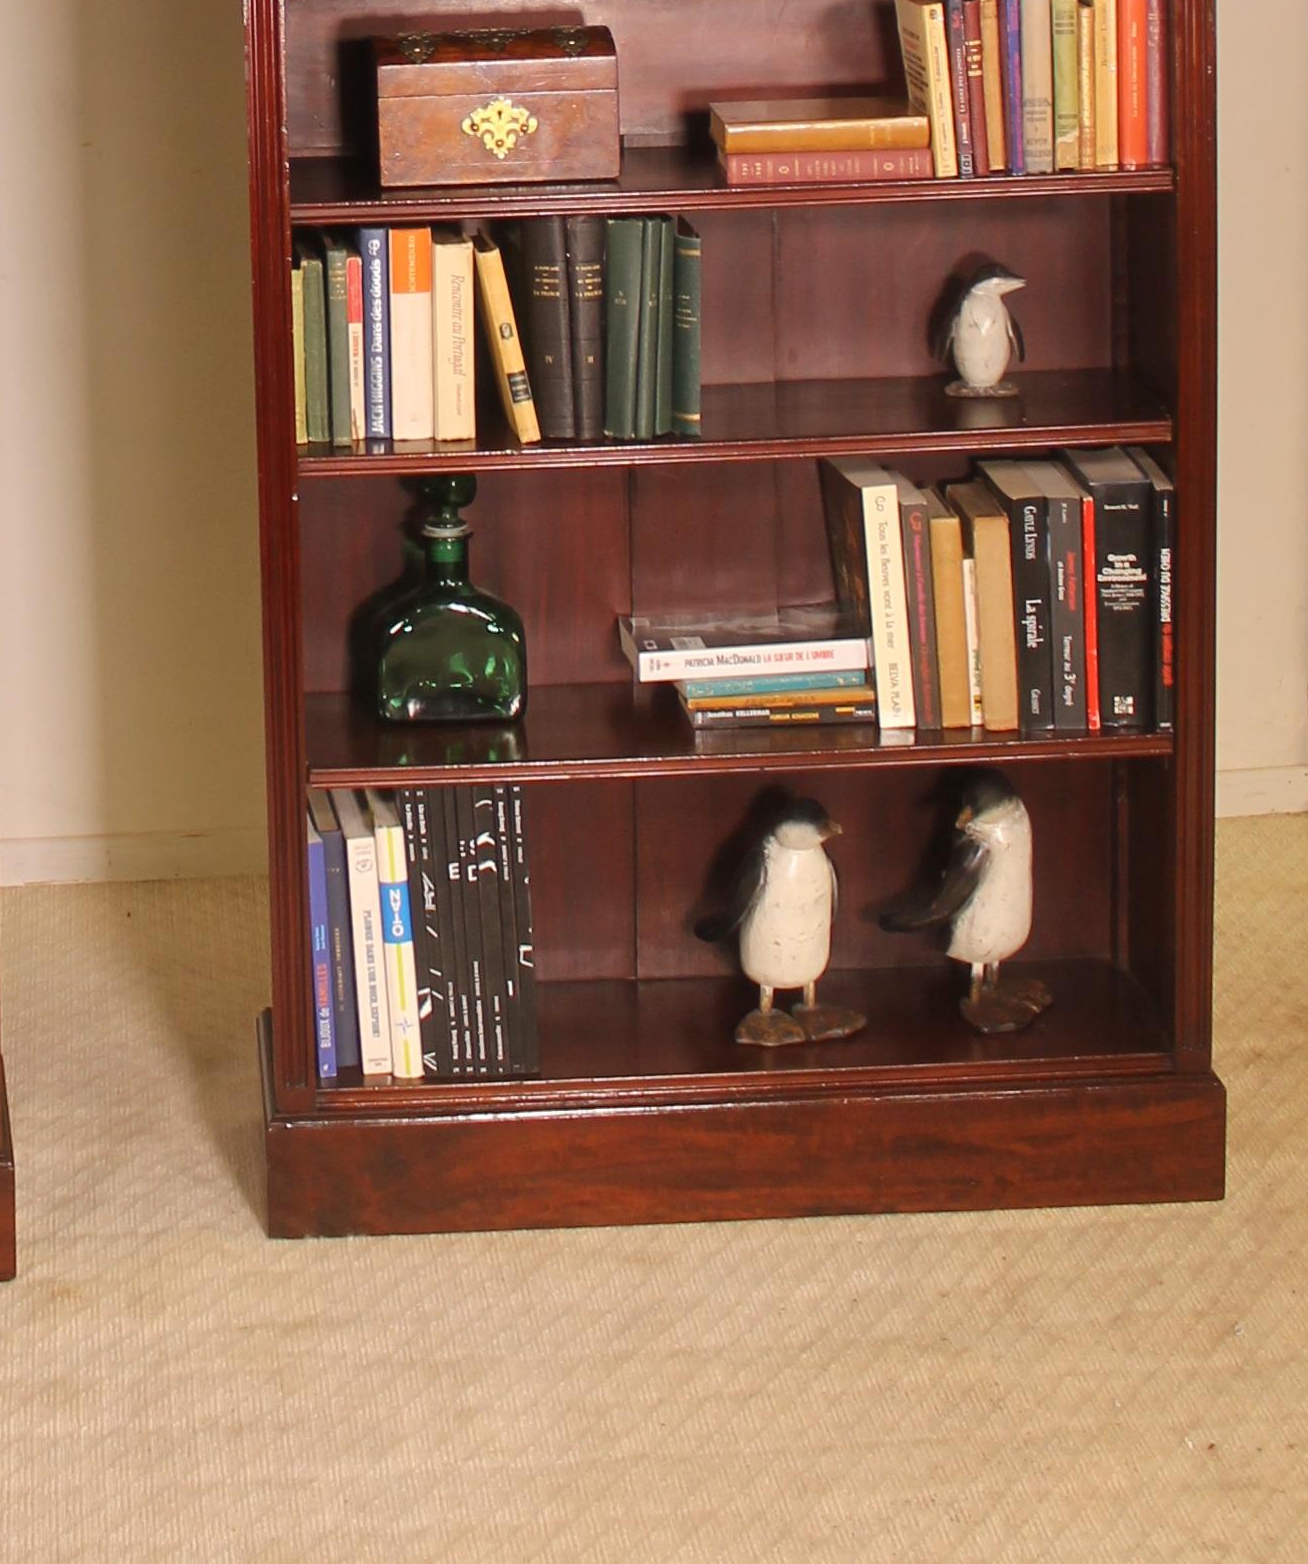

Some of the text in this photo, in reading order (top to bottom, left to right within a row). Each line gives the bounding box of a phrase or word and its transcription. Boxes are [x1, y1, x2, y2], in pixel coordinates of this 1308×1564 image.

[450, 274, 466, 319] Rencontre
[372, 299, 382, 321] des
[372, 323, 383, 353] Dans
[453, 321, 463, 335] au
[447, 335, 466, 377] Portugal
[370, 356, 384, 403] HIGGINS
[371, 404, 384, 434] JACK
[878, 520, 888, 541] Tous
[1024, 506, 1037, 560] GAYLE LYNDS
[879, 543, 890, 555] les
[1107, 553, 1137, 562] Growth
[881, 557, 892, 587] fleuves
[1097, 573, 1147, 582] Environment
[1102, 567, 1143, 576] Changing
[883, 589, 893, 609] vont
[884, 611, 895, 619] à
[885, 620, 895, 629] la
[1022, 599, 1044, 649] La spirale
[886, 631, 896, 649] mer
[1063, 635, 1073, 661] Terreur
[684, 657, 715, 669] PATRICIA
[763, 653, 773, 664] LA
[795, 650, 805, 661] DE
[1064, 661, 1072, 671] au
[888, 662, 899, 689] BELVA
[1063, 685, 1076, 707] degré
[366, 943, 376, 965] DANS
[317, 963, 329, 1008] FAMILLES
[318, 1007, 330, 1018] de
[319, 1018, 332, 1048] BIJOUX
